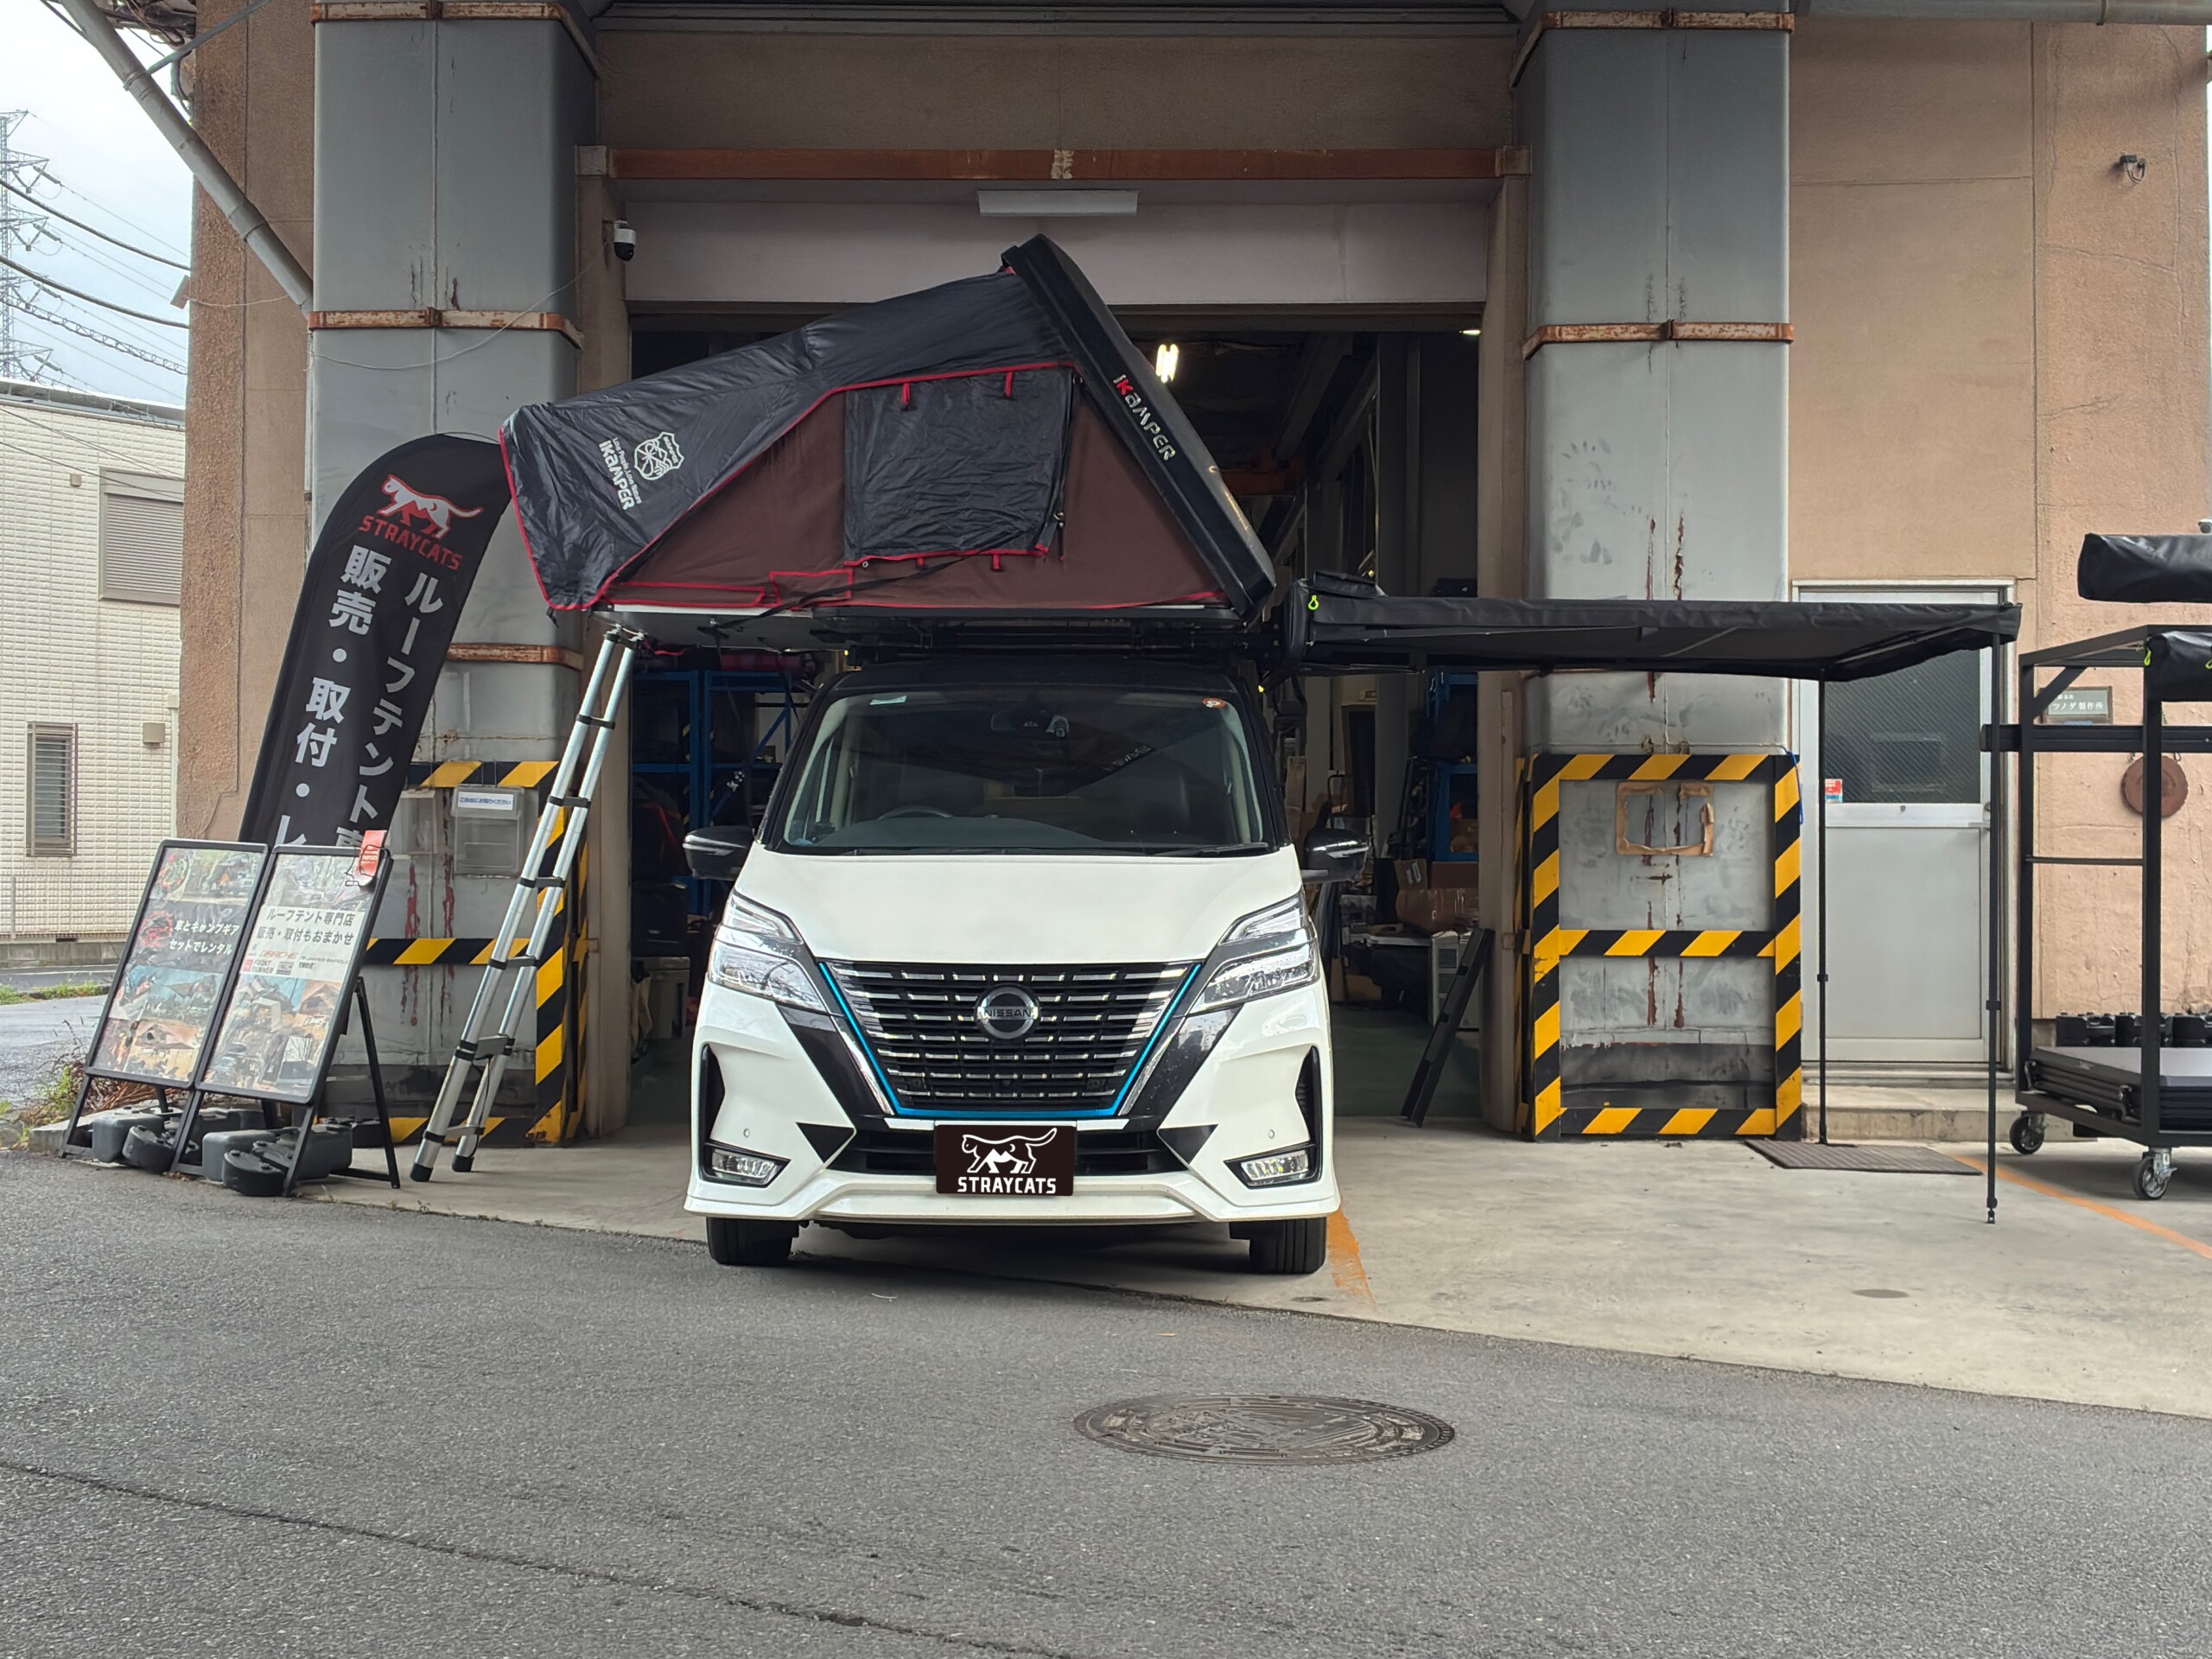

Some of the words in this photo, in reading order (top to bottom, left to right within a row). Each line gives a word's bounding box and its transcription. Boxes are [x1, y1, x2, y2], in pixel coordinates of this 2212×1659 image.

[359, 514, 463, 570] STRAYCATS
[266, 908, 355, 927] ルーフテント専門店
[257, 925, 354, 945] 販売・取付もおまかせ
[169, 938, 232, 955] セットでレンタル
[984, 1008, 1033, 1018] NISSAN
[957, 1176, 1057, 1194] STRAYCATS
